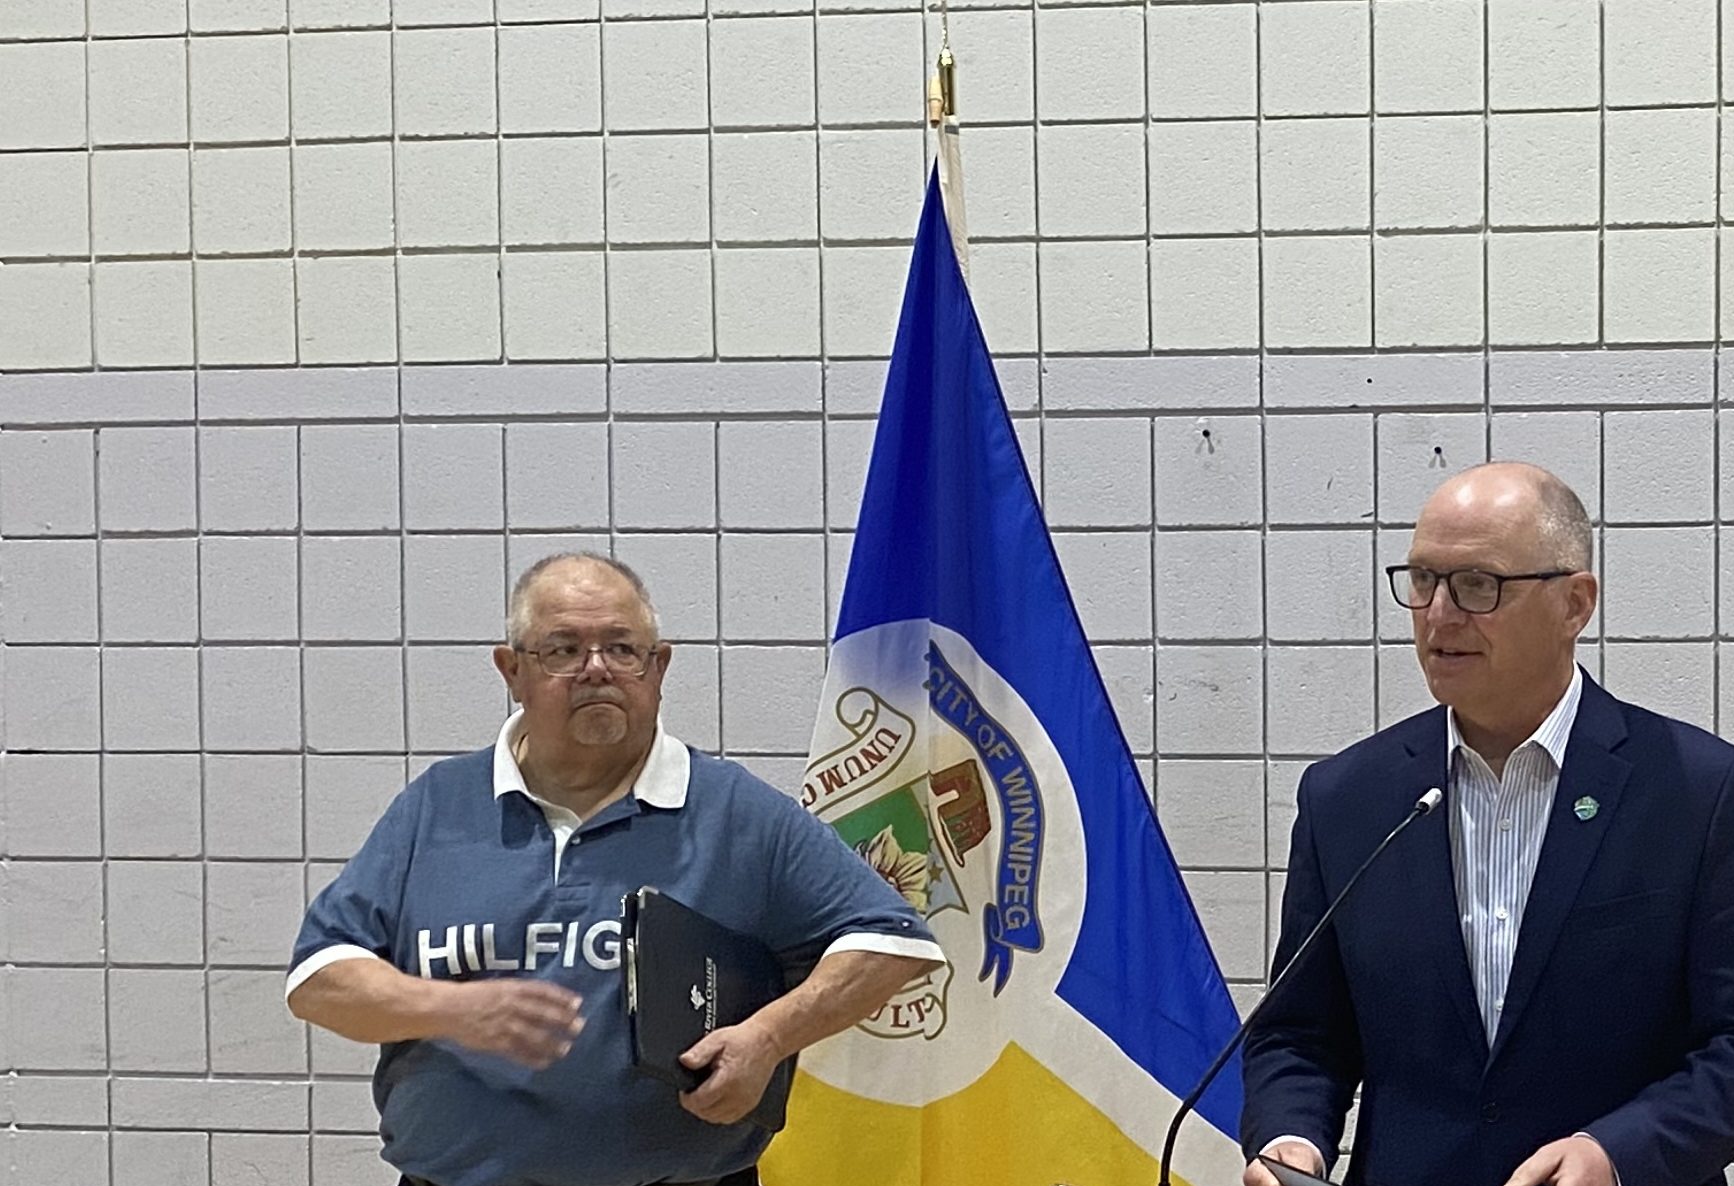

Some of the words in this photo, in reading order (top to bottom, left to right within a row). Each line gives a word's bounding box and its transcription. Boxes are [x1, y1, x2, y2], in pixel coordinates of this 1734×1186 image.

[815, 727, 903, 797] UNUM
[929, 667, 979, 727] CITY
[978, 724, 1015, 761] OF
[1000, 765, 1036, 930] WINNIPEG
[417, 920, 622, 979] HILFIG
